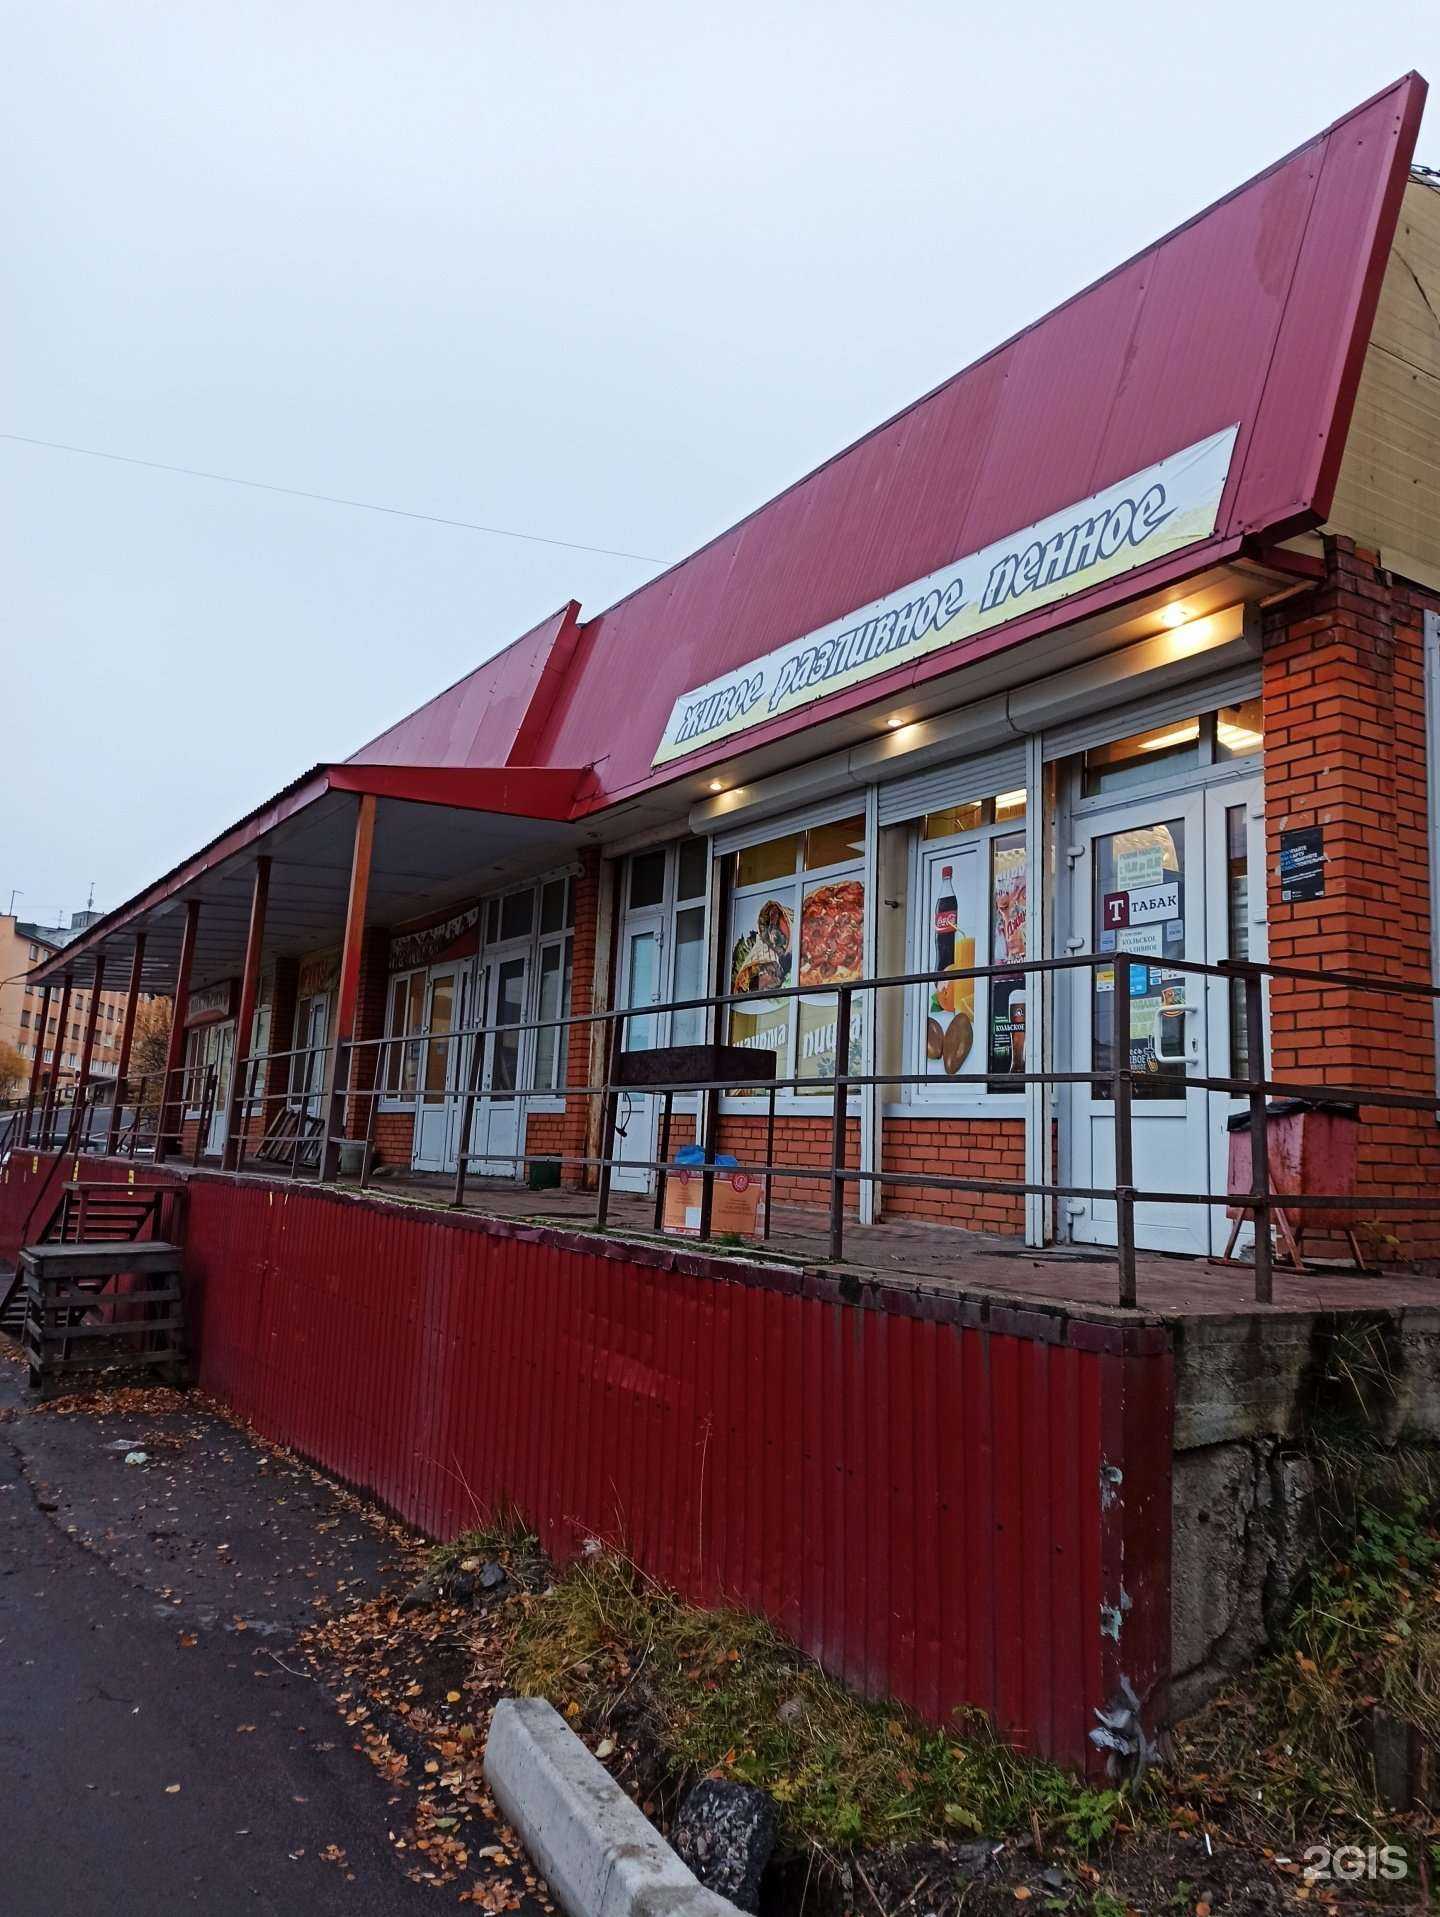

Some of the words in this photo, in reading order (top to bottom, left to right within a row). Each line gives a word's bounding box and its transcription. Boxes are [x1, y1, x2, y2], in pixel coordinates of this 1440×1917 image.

[767, 578, 968, 712] разливное
[979, 483, 1178, 614] пенное
[1131, 895, 1177, 913] ТАБАК
